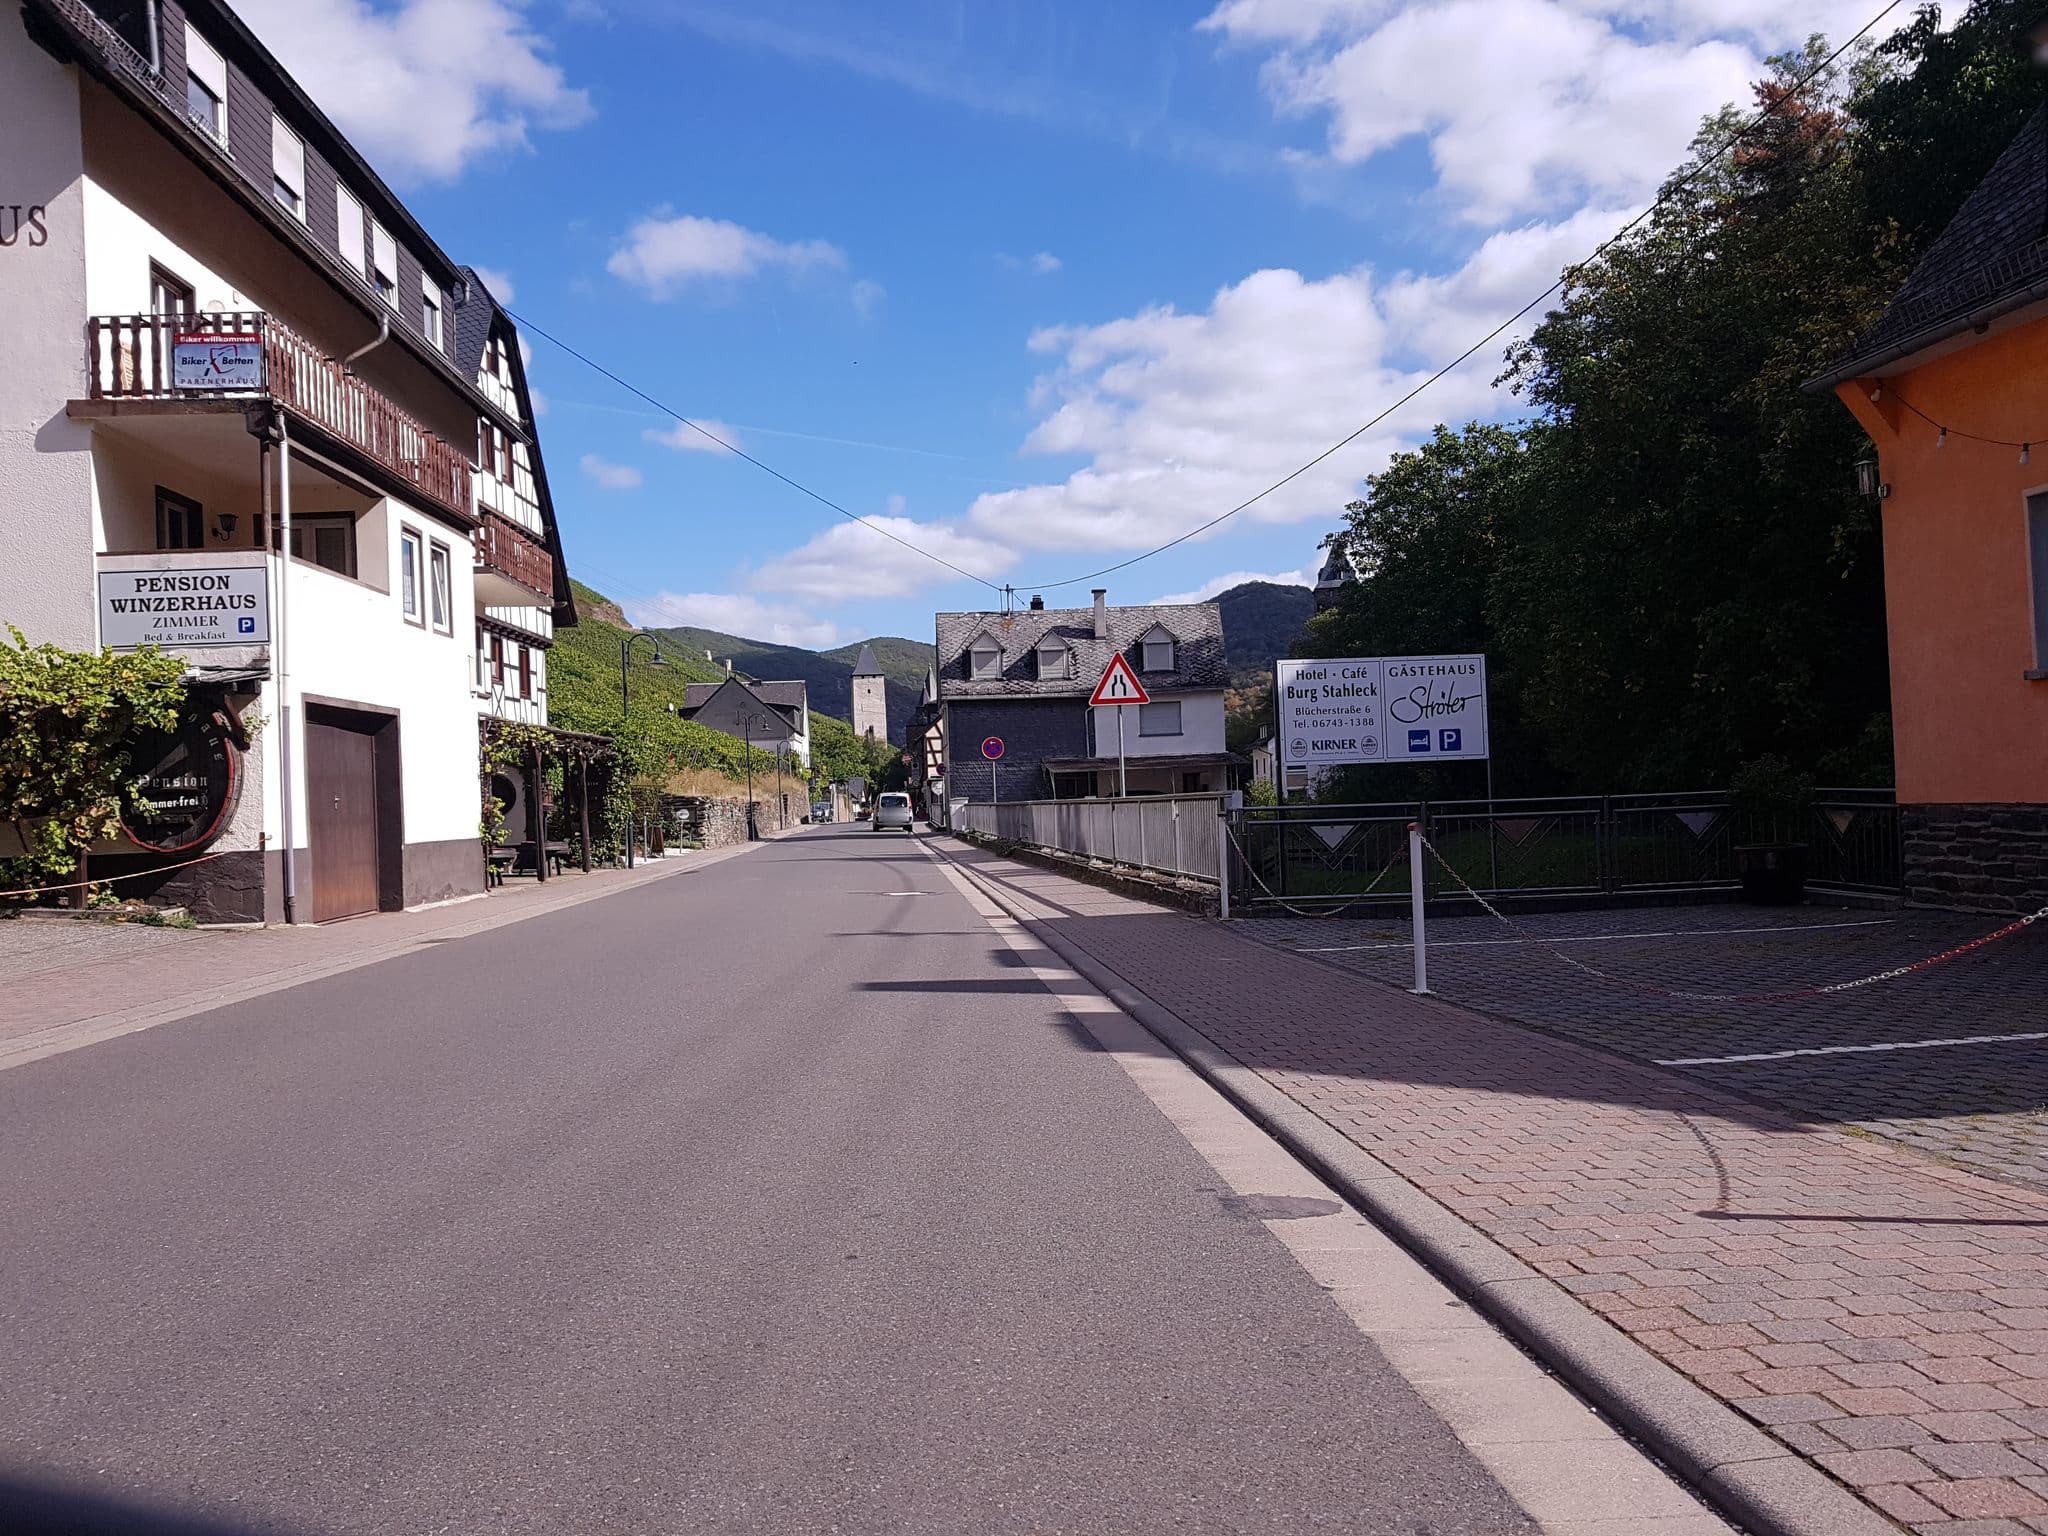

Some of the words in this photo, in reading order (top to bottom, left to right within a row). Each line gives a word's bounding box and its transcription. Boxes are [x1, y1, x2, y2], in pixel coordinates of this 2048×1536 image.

[203, 335, 256, 343] willkommen
[181, 356, 207, 365] Biker
[222, 356, 254, 365] Betten
[180, 378, 257, 386] PARTNERHAUS
[134, 575, 231, 593] PENSION
[110, 594, 257, 613] WINZERHAUS
[152, 615, 219, 629] ZIMMER
[144, 632, 163, 642] Bed
[165, 633, 174, 642] &
[177, 631, 227, 642] Breakfast
[1295, 668, 1328, 681] Hotel
[1341, 667, 1368, 680] Café
[1388, 663, 1477, 678] GÄSTEHAUS
[1287, 685, 1318, 702] Burg
[1322, 682, 1378, 699] Stahleck
[1295, 705, 1362, 717] Blücherstraße
[1364, 706, 1371, 714] 6
[1292, 719, 1310, 729] Tel.
[1312, 717, 1375, 729] 06743-1388
[1311, 738, 1358, 751] KIRNER
[137, 773, 208, 788] Pension
